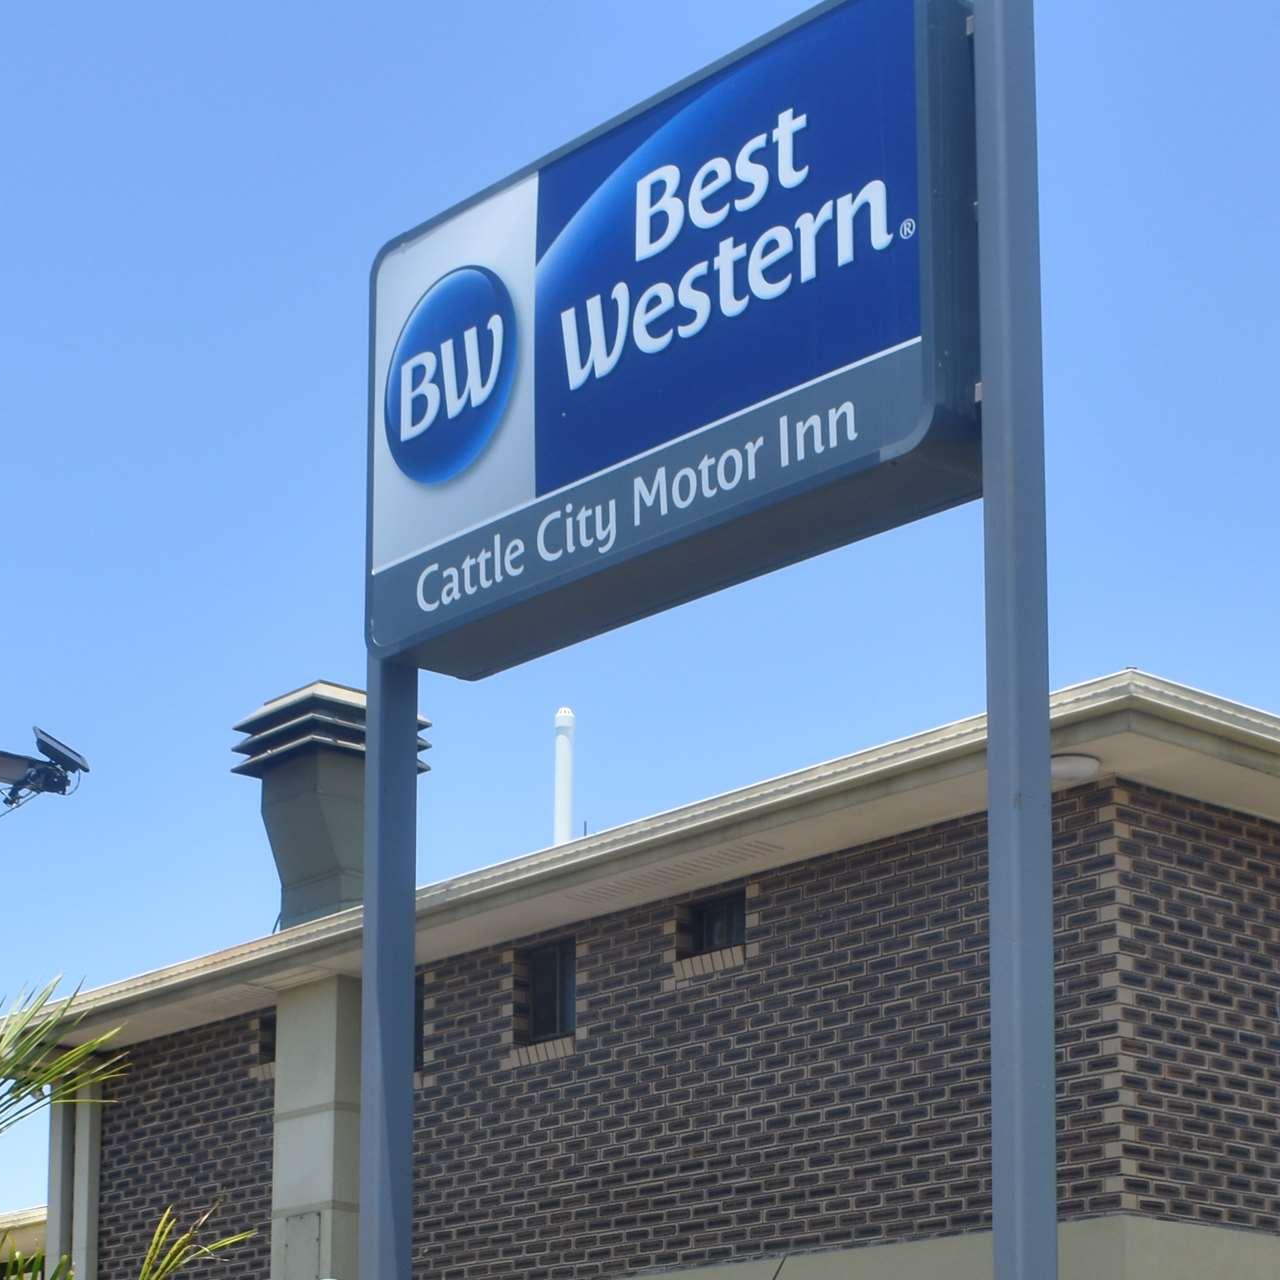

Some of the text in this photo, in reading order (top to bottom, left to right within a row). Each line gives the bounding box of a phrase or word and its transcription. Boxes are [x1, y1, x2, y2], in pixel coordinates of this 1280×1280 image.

[634, 106, 810, 263] Best
[398, 313, 505, 443] BW
[415, 400, 859, 613] Cattle City Motor Inn
